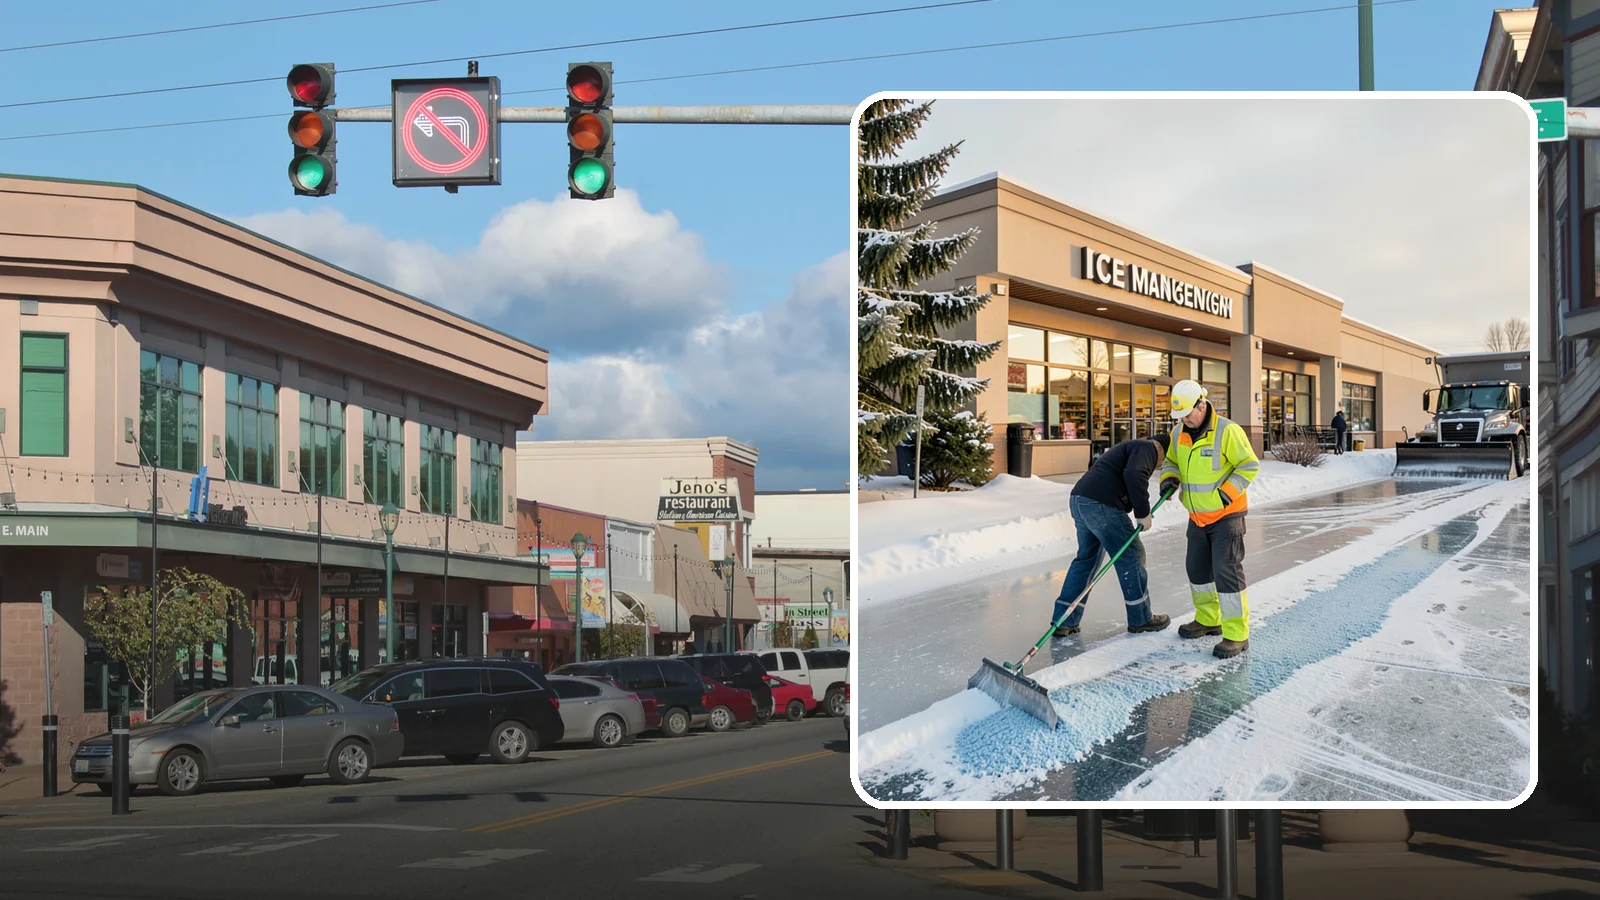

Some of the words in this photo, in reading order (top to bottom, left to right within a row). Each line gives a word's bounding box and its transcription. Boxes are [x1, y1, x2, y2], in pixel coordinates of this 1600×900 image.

[1083, 246, 1125, 288] ICE
[670, 480, 728, 495] Jeno's
[665, 496, 731, 509] restaurant
[659, 510, 681, 520] Italian
[686, 509, 714, 519] American
[715, 509, 737, 519] Cuisine
[2, 525, 13, 536] E.
[15, 525, 49, 537] MAIN
[797, 608, 828, 616] Street
[791, 619, 823, 627] lass
